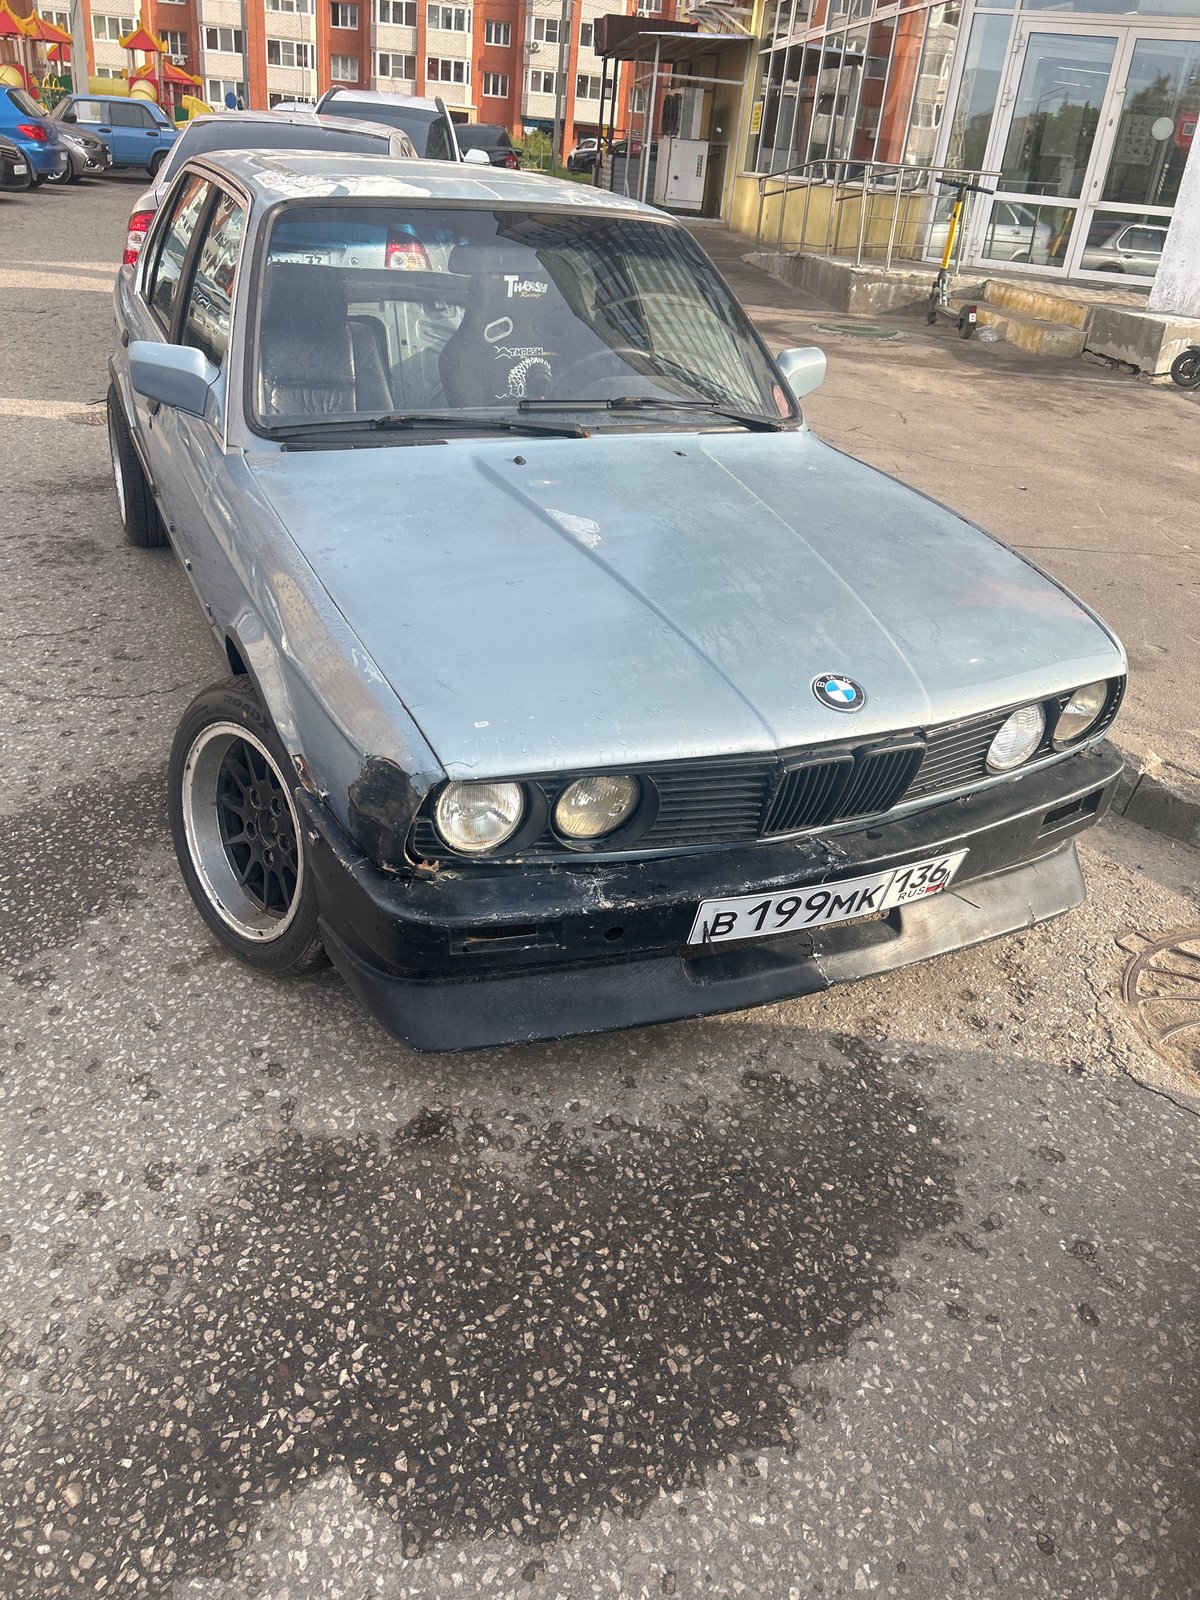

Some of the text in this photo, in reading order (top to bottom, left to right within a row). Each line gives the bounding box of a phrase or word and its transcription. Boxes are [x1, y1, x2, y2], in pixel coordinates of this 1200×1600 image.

[223, 694, 272, 736] ROADX
[895, 858, 951, 893] 136
[897, 886, 926, 902] RUS
